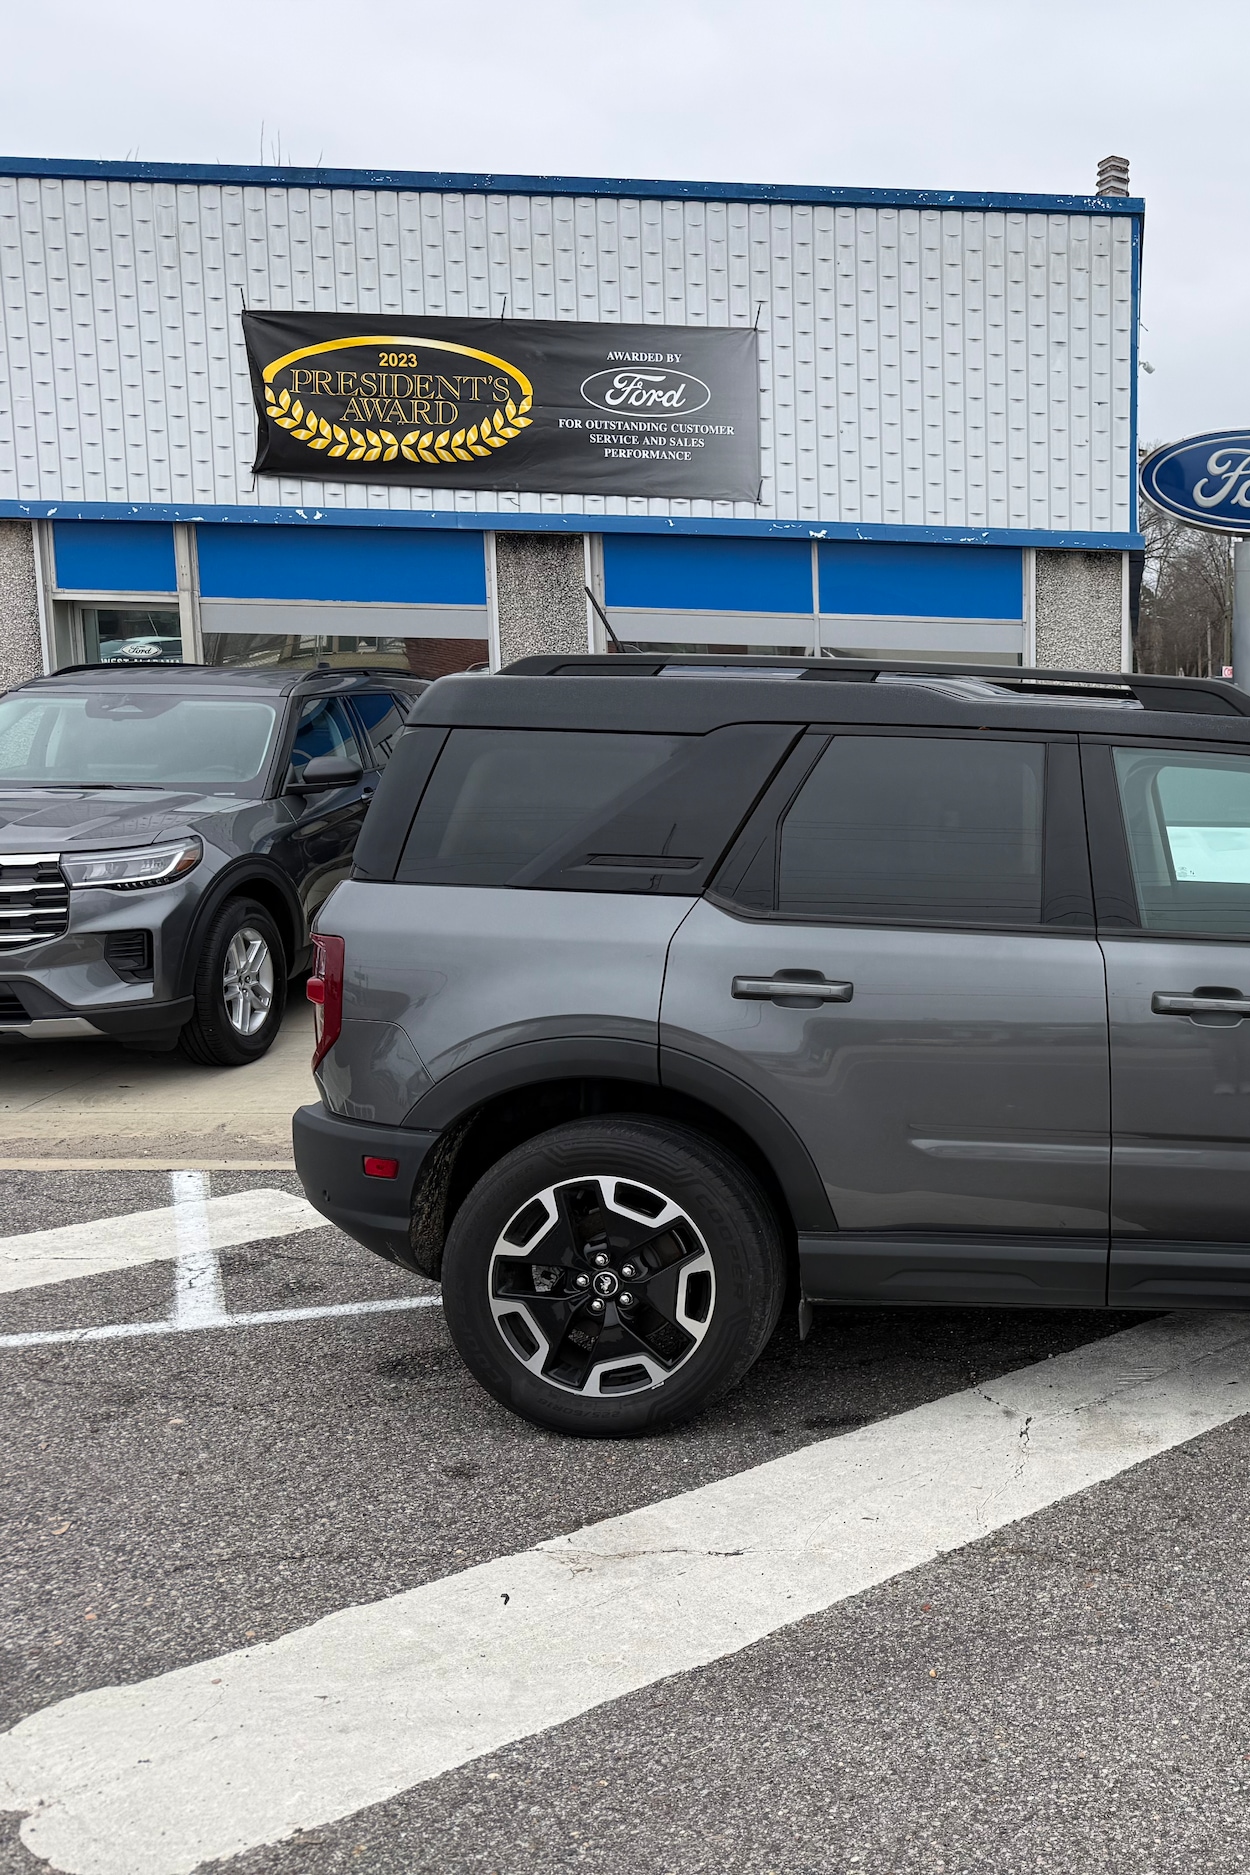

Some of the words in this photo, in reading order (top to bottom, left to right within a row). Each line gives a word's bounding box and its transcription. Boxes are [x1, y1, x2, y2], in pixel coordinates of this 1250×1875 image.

[378, 352, 418, 368] 2023
[606, 351, 663, 363] AWARDED
[666, 353, 682, 363] BY
[289, 368, 511, 402] PRESIDENT'S
[604, 372, 687, 408] Ford
[339, 397, 459, 425] AWARD
[558, 418, 582, 429] FOR
[585, 419, 668, 433] OUTSTANDING
[671, 423, 735, 436] CUSTOMER
[589, 433, 639, 445] SERVICE
[642, 435, 667, 446] AND
[669, 436, 705, 448] SALES
[604, 447, 692, 461] PERFORMANCE
[128, 646, 152, 655] Ford
[694, 1192, 745, 1301] COOPER
